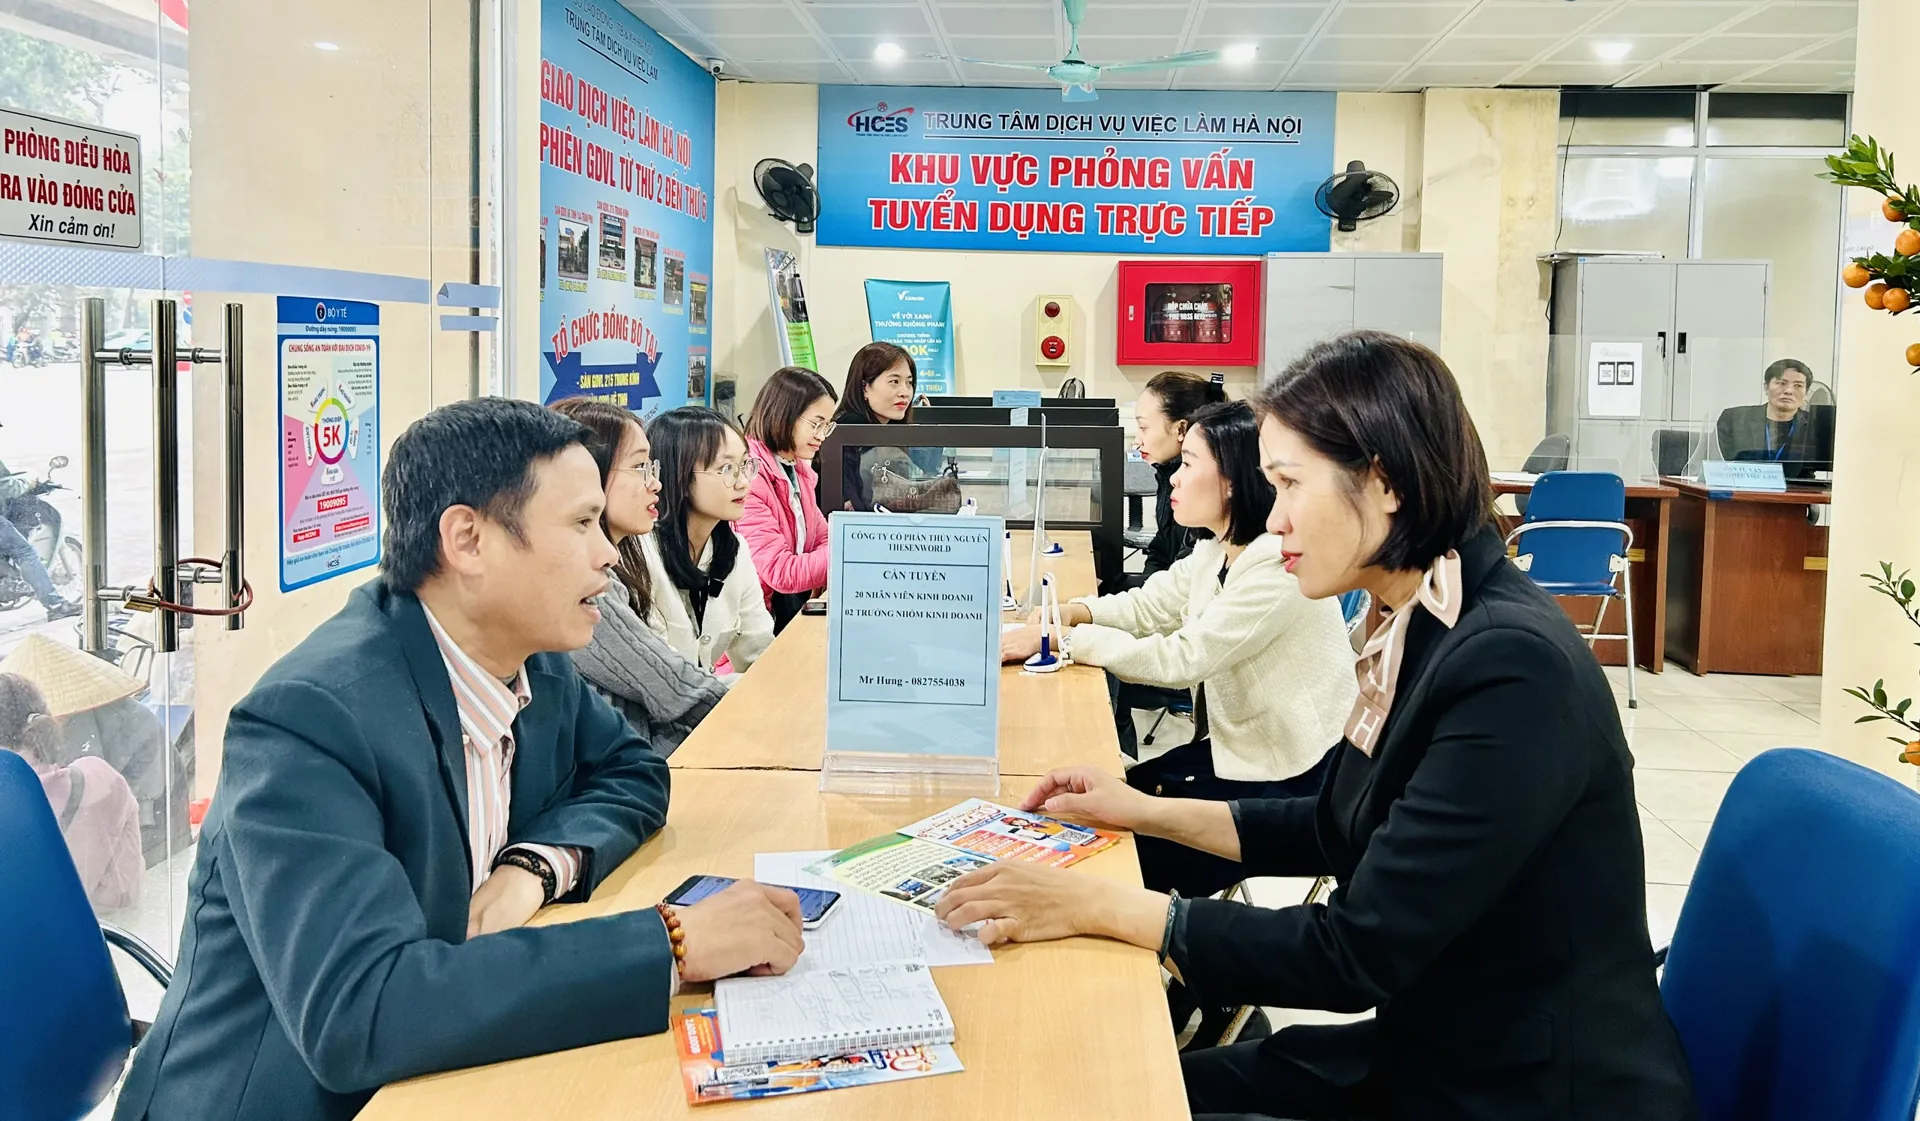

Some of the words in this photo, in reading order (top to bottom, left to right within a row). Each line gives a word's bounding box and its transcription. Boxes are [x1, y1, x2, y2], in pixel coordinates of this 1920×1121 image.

[565, 7, 590, 37] TRUNG
[607, 36, 622, 57] DỊCH
[540, 59, 574, 111] GIAO
[578, 78, 608, 129] DỊCH
[611, 95, 636, 145] VIỆC
[639, 108, 660, 152] LÀM
[662, 121, 674, 160] HÀ
[676, 130, 692, 172] NỘI
[856, 115, 909, 133] HCES
[924, 112, 992, 130] TRUNG
[999, 109, 1040, 131] TÂM
[1046, 113, 1093, 135] DỊCH
[1099, 115, 1126, 136] VỤ
[1132, 114, 1178, 136] VIỆC
[1184, 113, 1227, 133] LÀM
[1233, 114, 1261, 134] HÀ
[1267, 115, 1303, 137] NỘI
[4, 127, 60, 163] PHÒNG
[64, 135, 99, 169] ĐIỀU
[103, 143, 131, 175] HÒA
[540, 122, 582, 175] PHIÊN
[586, 142, 616, 188] GDVL
[619, 152, 634, 193] TỪ
[636, 162, 656, 201] THỨ
[657, 173, 663, 204] 2
[665, 170, 683, 212] ĐẾN
[890, 153, 960, 184] KHU
[971, 152, 1038, 192] VỰC
[1050, 147, 1170, 189] PHỎNG
[1182, 147, 1254, 190] VẤN
[0, 173, 22, 201] RA
[27, 174, 58, 206] VÀO
[63, 180, 104, 212] ĐÓNG
[108, 184, 136, 216] CỬA
[28, 214, 54, 232] Xin
[58, 216, 88, 236] cảm
[93, 223, 115, 238] ơn!
[869, 189, 978, 231] TUYỂN
[989, 201, 1084, 238] DỤNG
[1096, 202, 1186, 241] TRỰC
[1197, 196, 1274, 237] TIẾP
[327, 307, 336, 319] BỘ
[336, 308, 340, 318] Y
[340, 306, 348, 318] TẾ
[551, 314, 569, 363] TỔ
[571, 308, 600, 349] CHỨC
[631, 317, 643, 354] BỘ
[644, 327, 658, 363] TẠI
[580, 371, 591, 389] SÀN
[323, 424, 341, 448] 5K
[319, 496, 346, 510] 19009095
[851, 530, 875, 541] CÔNG
[876, 532, 888, 541] TY
[890, 531, 903, 541] CỔ
[904, 532, 927, 541] PHẦN
[888, 543, 952, 553] THESENWORLD
[883, 568, 907, 580] CẦN
[909, 569, 946, 582] TUYỂN
[855, 590, 864, 598] 20
[865, 589, 891, 599] NHÂN
[893, 590, 914, 600] VIÊN
[916, 592, 939, 601] KINH
[941, 593, 973, 602] DOANH
[844, 608, 854, 616] 02
[855, 608, 894, 618] TRƯỞNG
[896, 609, 923, 619] NHÓM
[926, 610, 948, 619] KINH
[950, 611, 983, 620] DOANH
[859, 675, 874, 685] Mr
[911, 677, 965, 687] 0827554038
